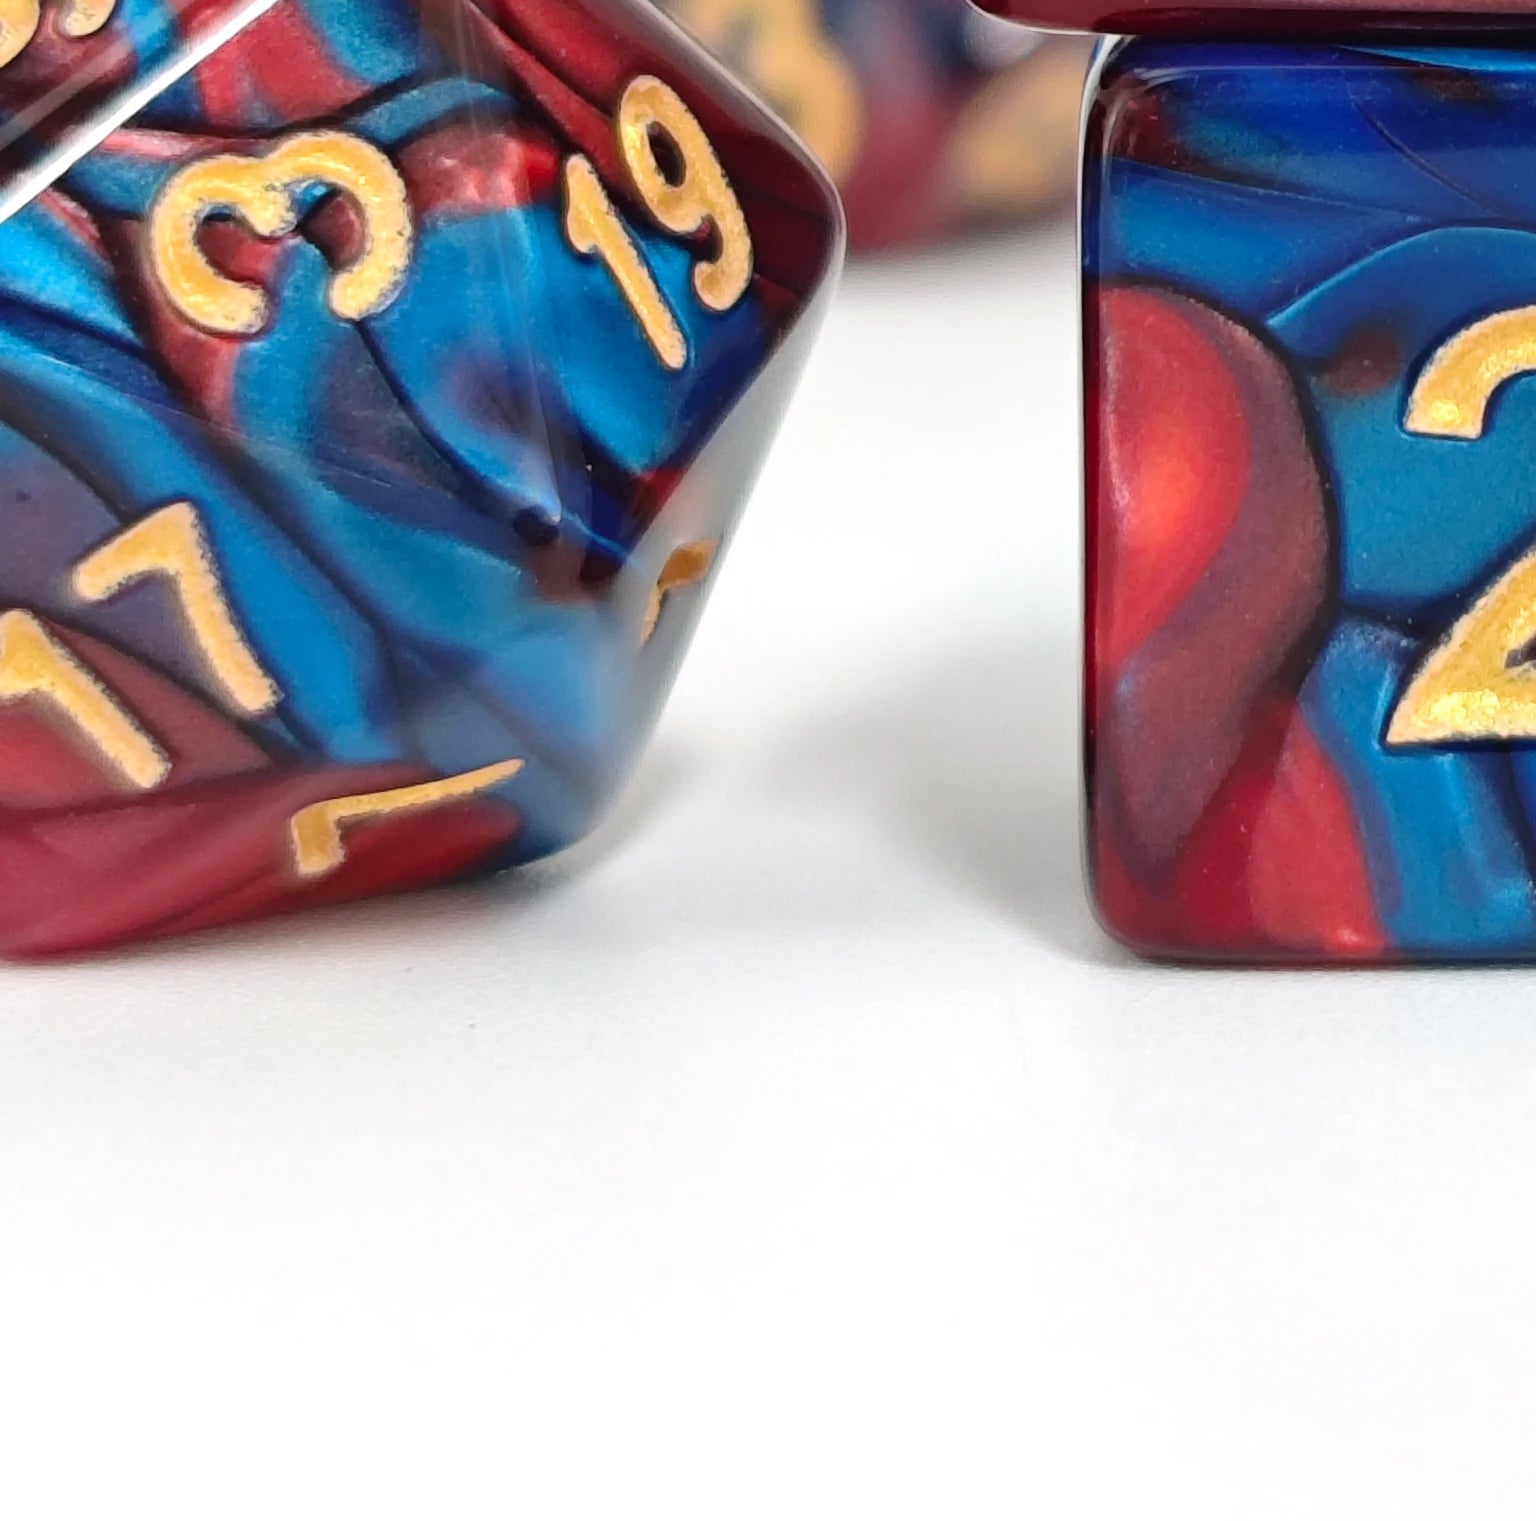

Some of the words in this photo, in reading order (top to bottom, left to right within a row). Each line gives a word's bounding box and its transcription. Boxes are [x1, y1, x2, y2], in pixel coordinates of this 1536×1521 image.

[149, 130, 415, 337] 3
[563, 75, 758, 372] 19
[0, 502, 284, 790] 17
